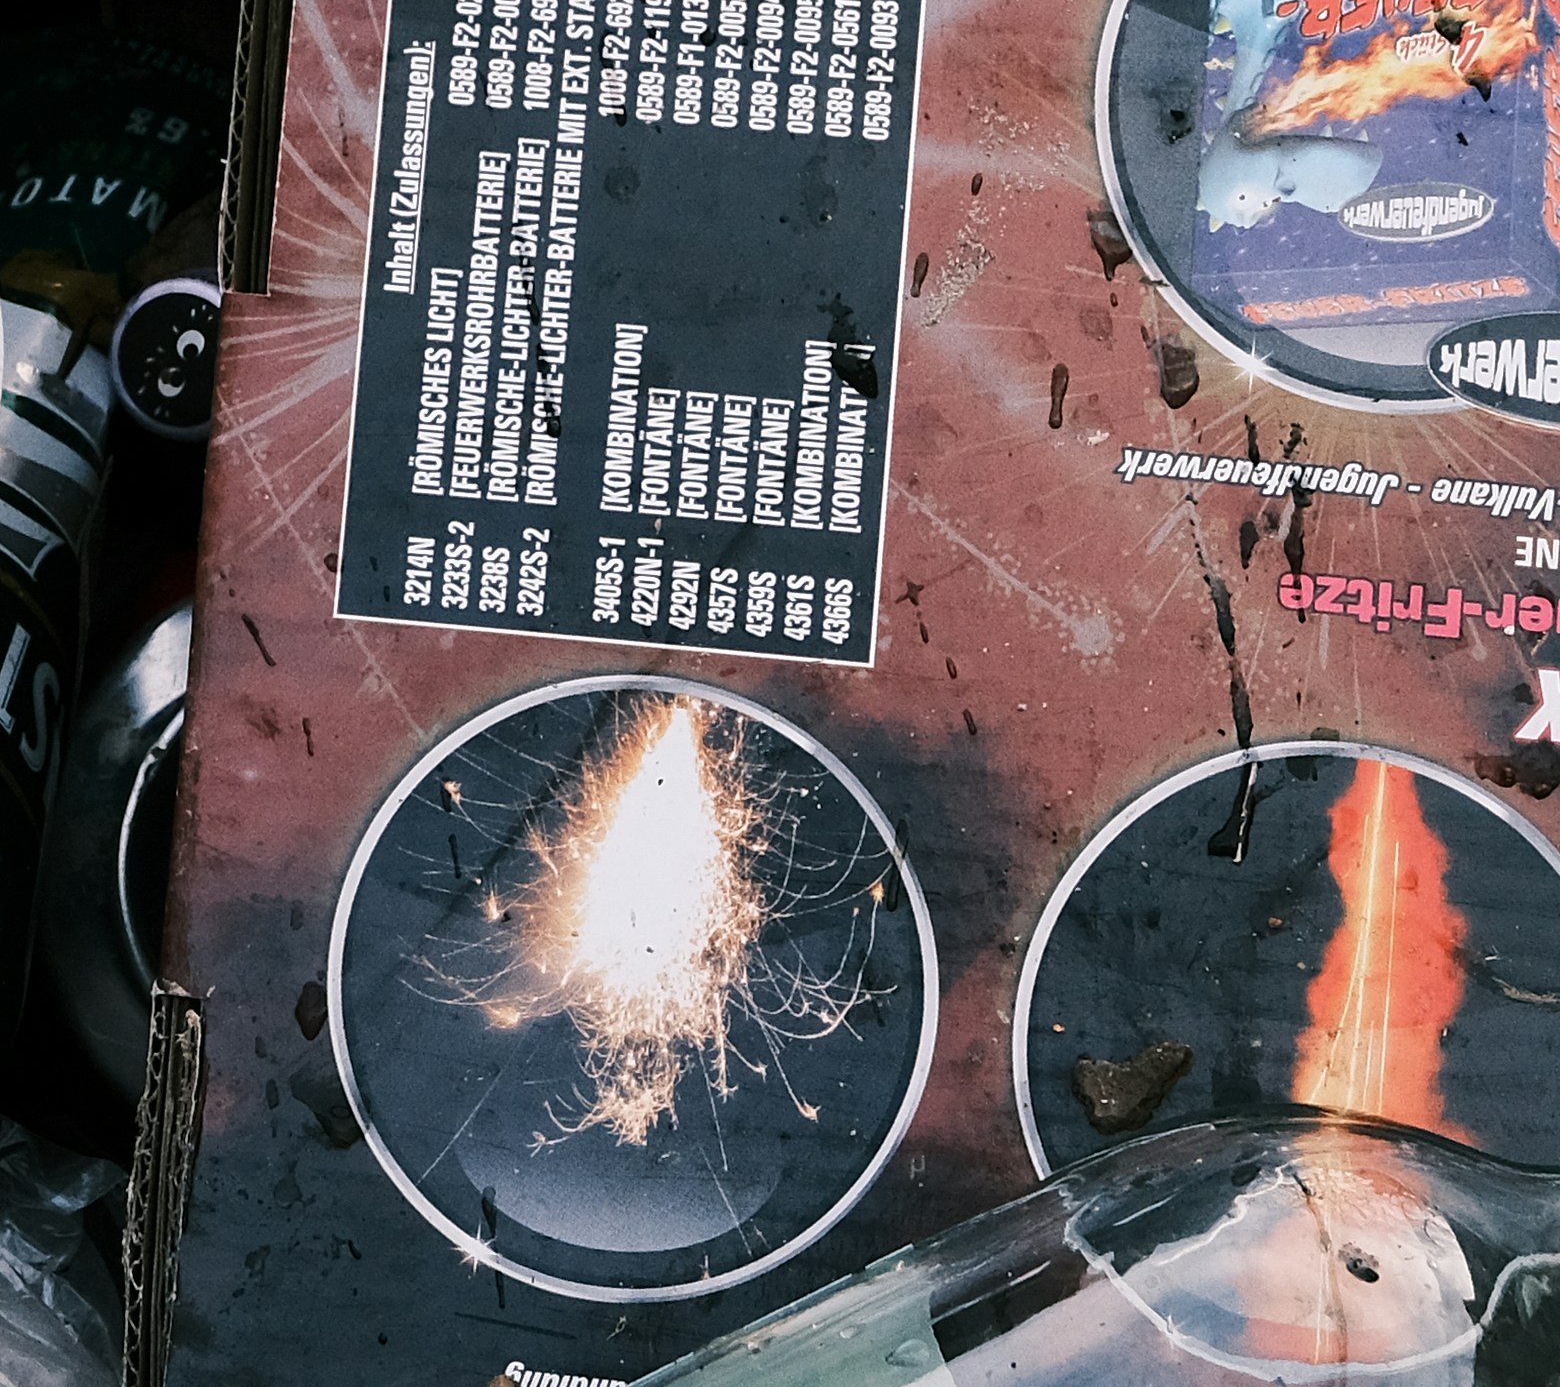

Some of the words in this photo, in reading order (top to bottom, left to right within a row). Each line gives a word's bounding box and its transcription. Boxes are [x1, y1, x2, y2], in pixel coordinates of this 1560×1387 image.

[560, 43, 593, 94] EXT.
[391, 38, 435, 217] (Zulassungen):
[555, 96, 588, 144] MIT
[382, 218, 420, 293] Inhalt
[425, 266, 462, 342] LICHT]
[451, 149, 511, 499] [FEUERWERKSROHRBATTERIE]
[490, 136, 550, 502] [RÖMISCHE-LICHTER-BATTERIE]
[527, 145, 586, 505] [RÖMISCHE-LICHTER-BATTERIE
[412, 346, 455, 495] [RÖMISCHES
[601, 321, 648, 513] [KOMBINATION]
[1114, 446, 1400, 507] Jugendfeuerwerk
[403, 535, 436, 606] 3214N
[442, 519, 477, 610] 3233S-2
[478, 545, 513, 613] 3238S
[516, 525, 552, 617] 3242S-2
[592, 534, 628, 623] 3405S-1
